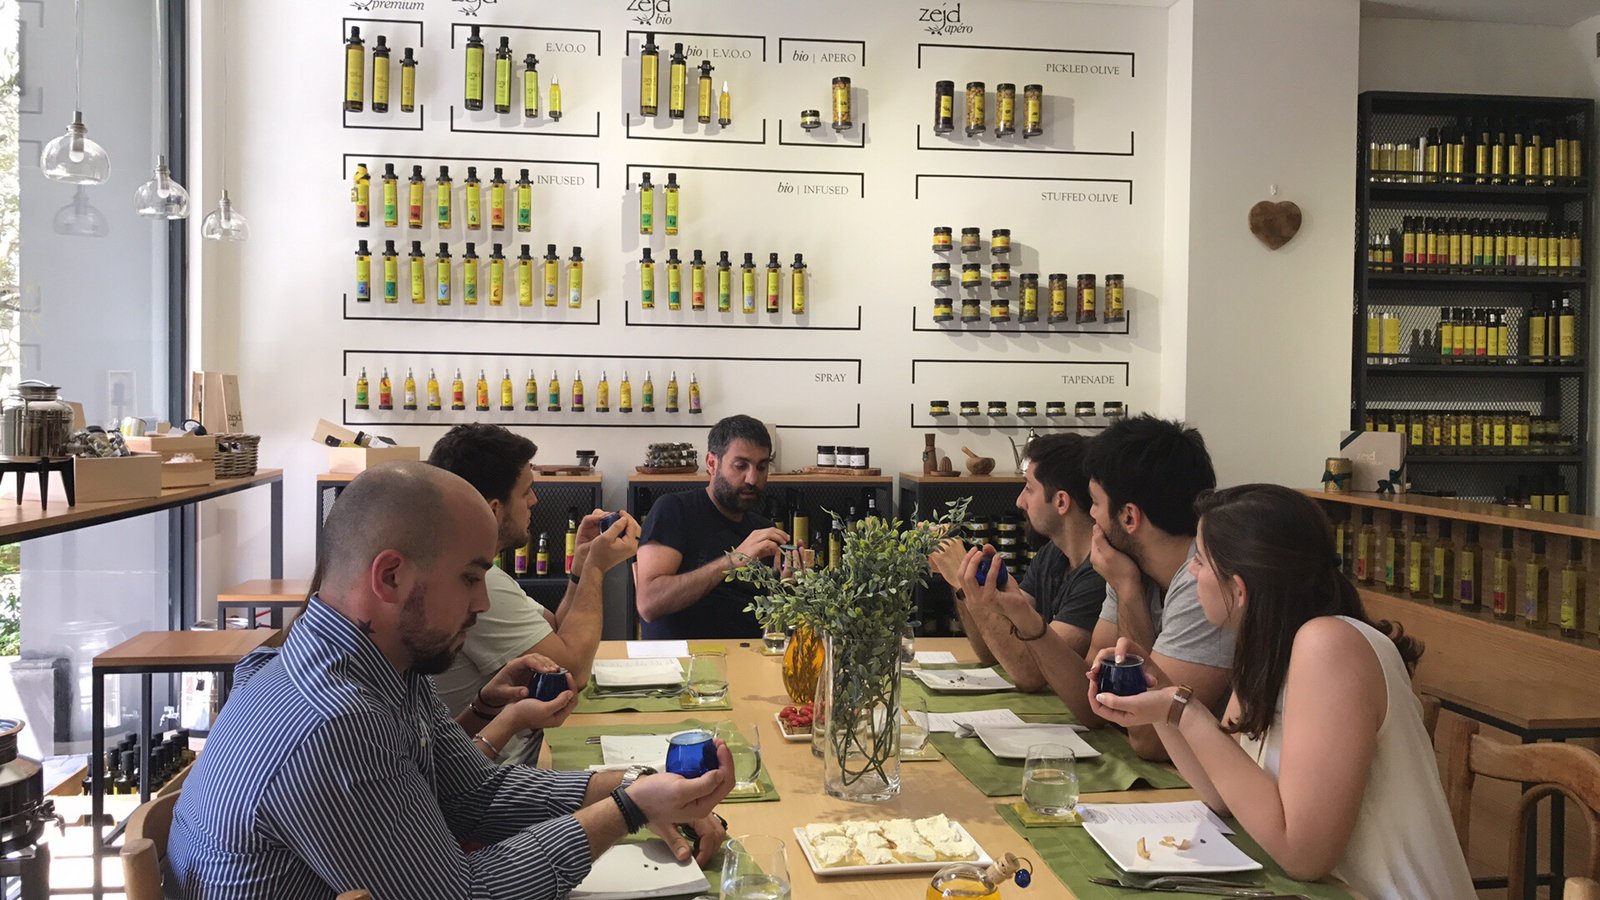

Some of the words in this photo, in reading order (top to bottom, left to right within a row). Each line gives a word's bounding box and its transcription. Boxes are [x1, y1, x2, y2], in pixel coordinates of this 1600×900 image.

[655, 13, 673, 25] bio
[919, 2, 961, 30] zejd
[944, 22, 974, 35] apéro
[545, 42, 587, 54] E.V.O.O
[685, 45, 703, 58] bio
[792, 50, 810, 62] bio
[820, 53, 857, 63] APERO
[1045, 63, 1089, 74] PICKLED
[1090, 66, 1120, 75] OLIVE
[537, 175, 585, 186] INFUSED
[777, 181, 795, 194] bio
[803, 185, 849, 195] INFUSED
[1041, 192, 1087, 202] STUFFED
[1088, 193, 1119, 203] OLIVE
[814, 373, 847, 383] SPRAY
[1061, 375, 1115, 385] TAPENADE
